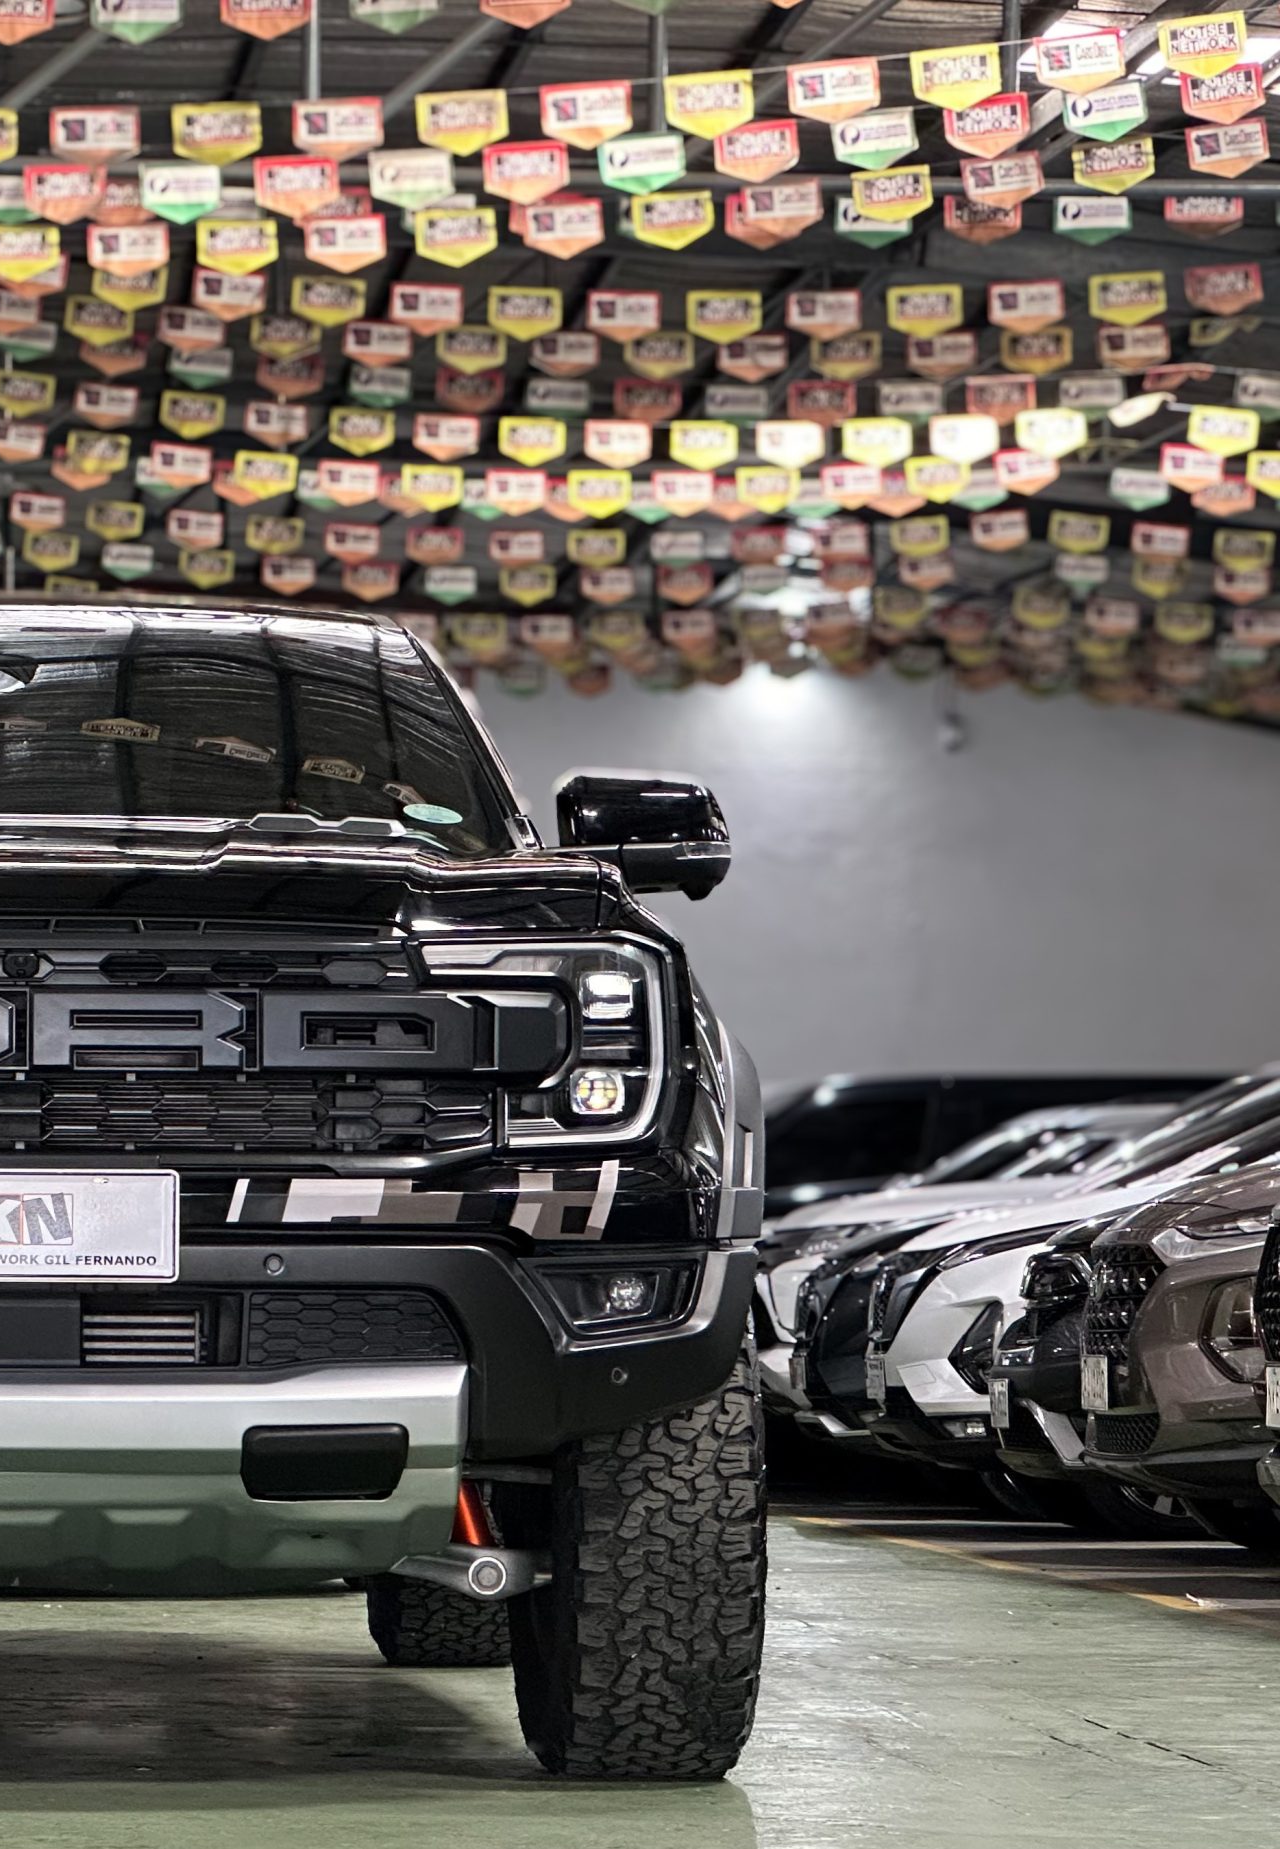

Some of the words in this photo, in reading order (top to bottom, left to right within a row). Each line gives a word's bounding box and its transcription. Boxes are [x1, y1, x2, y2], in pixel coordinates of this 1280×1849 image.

[1178, 23, 1227, 41] KOTSE
[1171, 36, 1237, 54] NETWORK
[1200, 72, 1244, 89] KOTSE
[1192, 82, 1254, 102] NETWORK
[963, 104, 1010, 121] KOTSE
[957, 115, 1019, 135] NETWORK
[44, 1254, 70, 1265] GIL
[75, 1255, 157, 1266] FERNANDO
